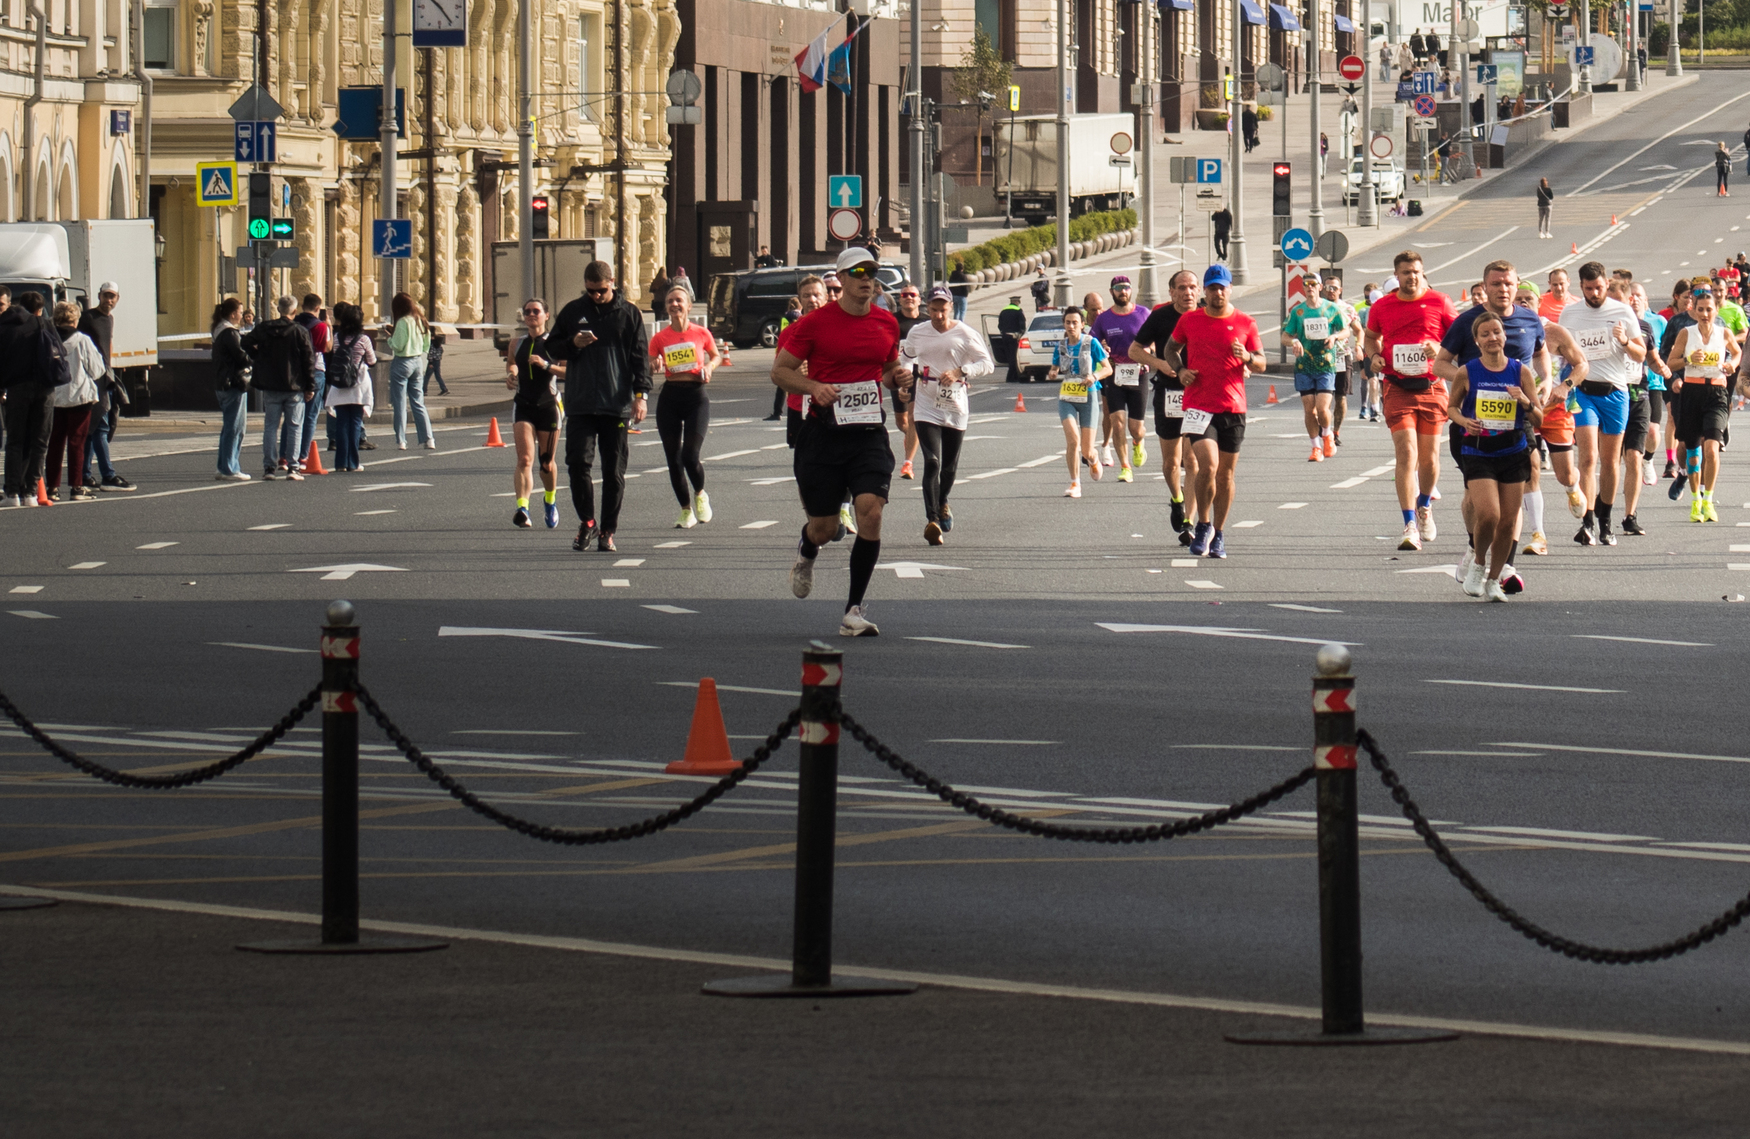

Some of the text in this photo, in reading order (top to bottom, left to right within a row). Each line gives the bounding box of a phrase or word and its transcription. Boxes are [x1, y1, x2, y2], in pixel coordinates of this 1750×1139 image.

[1580, 336, 1605, 348] 3464
[667, 349, 694, 362] 15541
[1395, 353, 1426, 363] 11606
[1063, 383, 1087, 393] 16373
[838, 391, 878, 409] 12502
[1481, 401, 1512, 414] 5590
